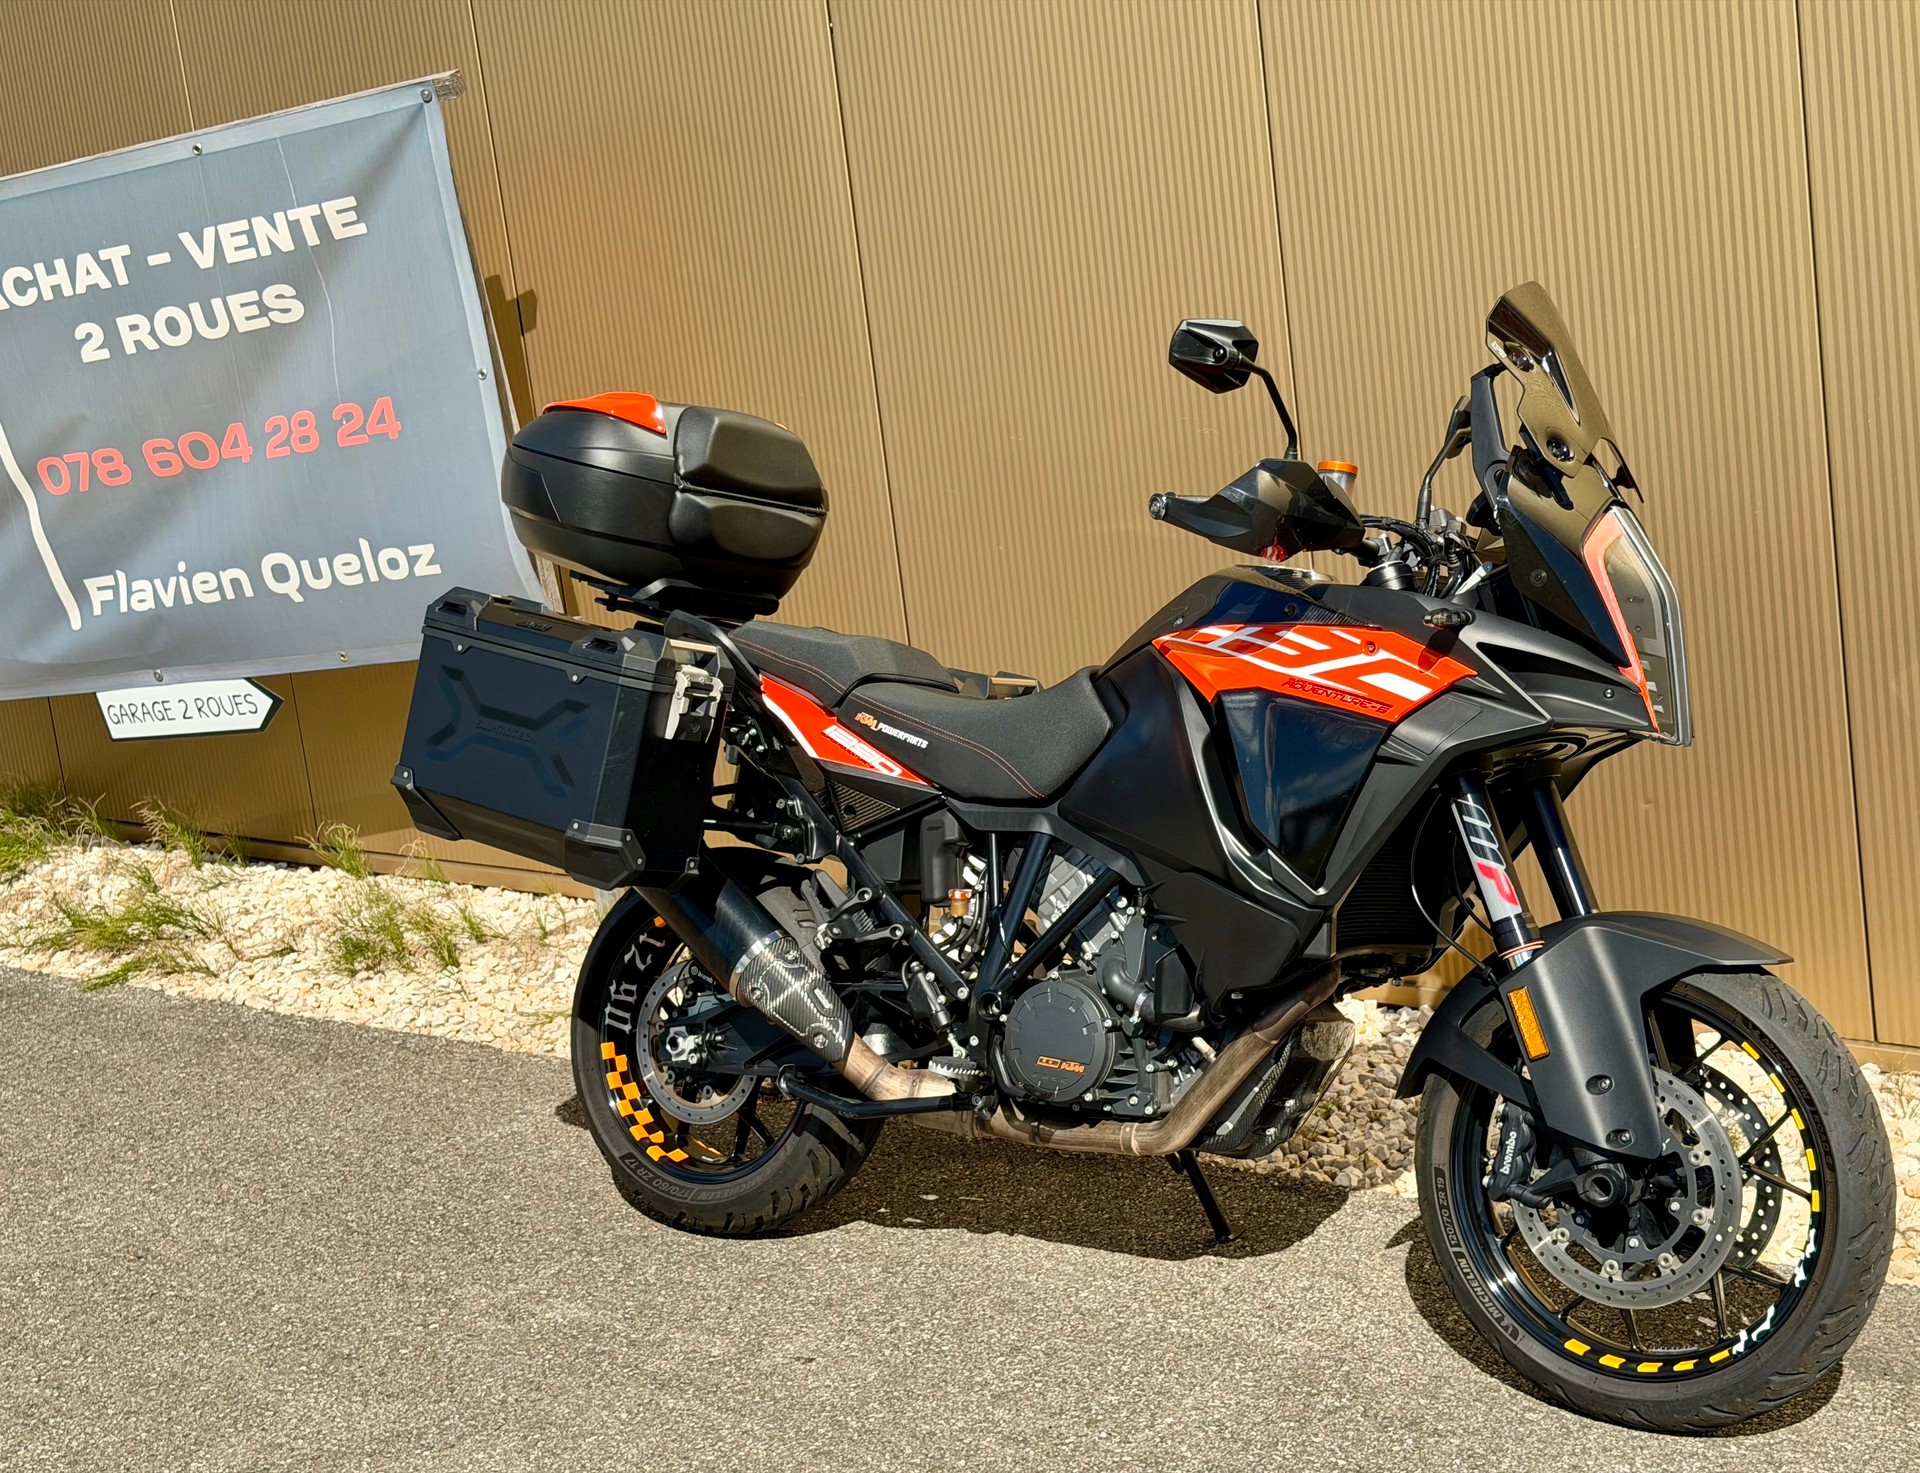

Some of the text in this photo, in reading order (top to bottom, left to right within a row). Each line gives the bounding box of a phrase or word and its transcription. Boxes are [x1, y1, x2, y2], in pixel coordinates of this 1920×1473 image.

[178, 196, 368, 269] VENTE
[74, 284, 305, 363] 2 ROUES
[37, 396, 401, 495] 078 604 28 24
[83, 537, 442, 616] Flavien Queloz
[107, 693, 258, 725] GARAGE 2 ROUES
[878, 722, 929, 749] POWERPARTS
[822, 725, 902, 777] 1290
[625, 1158, 690, 1199] 170/60 ZR 17
[1500, 1131, 1517, 1175] brembo
[1437, 1177, 1503, 1320] MICHELIN 120/70 ZR 19
